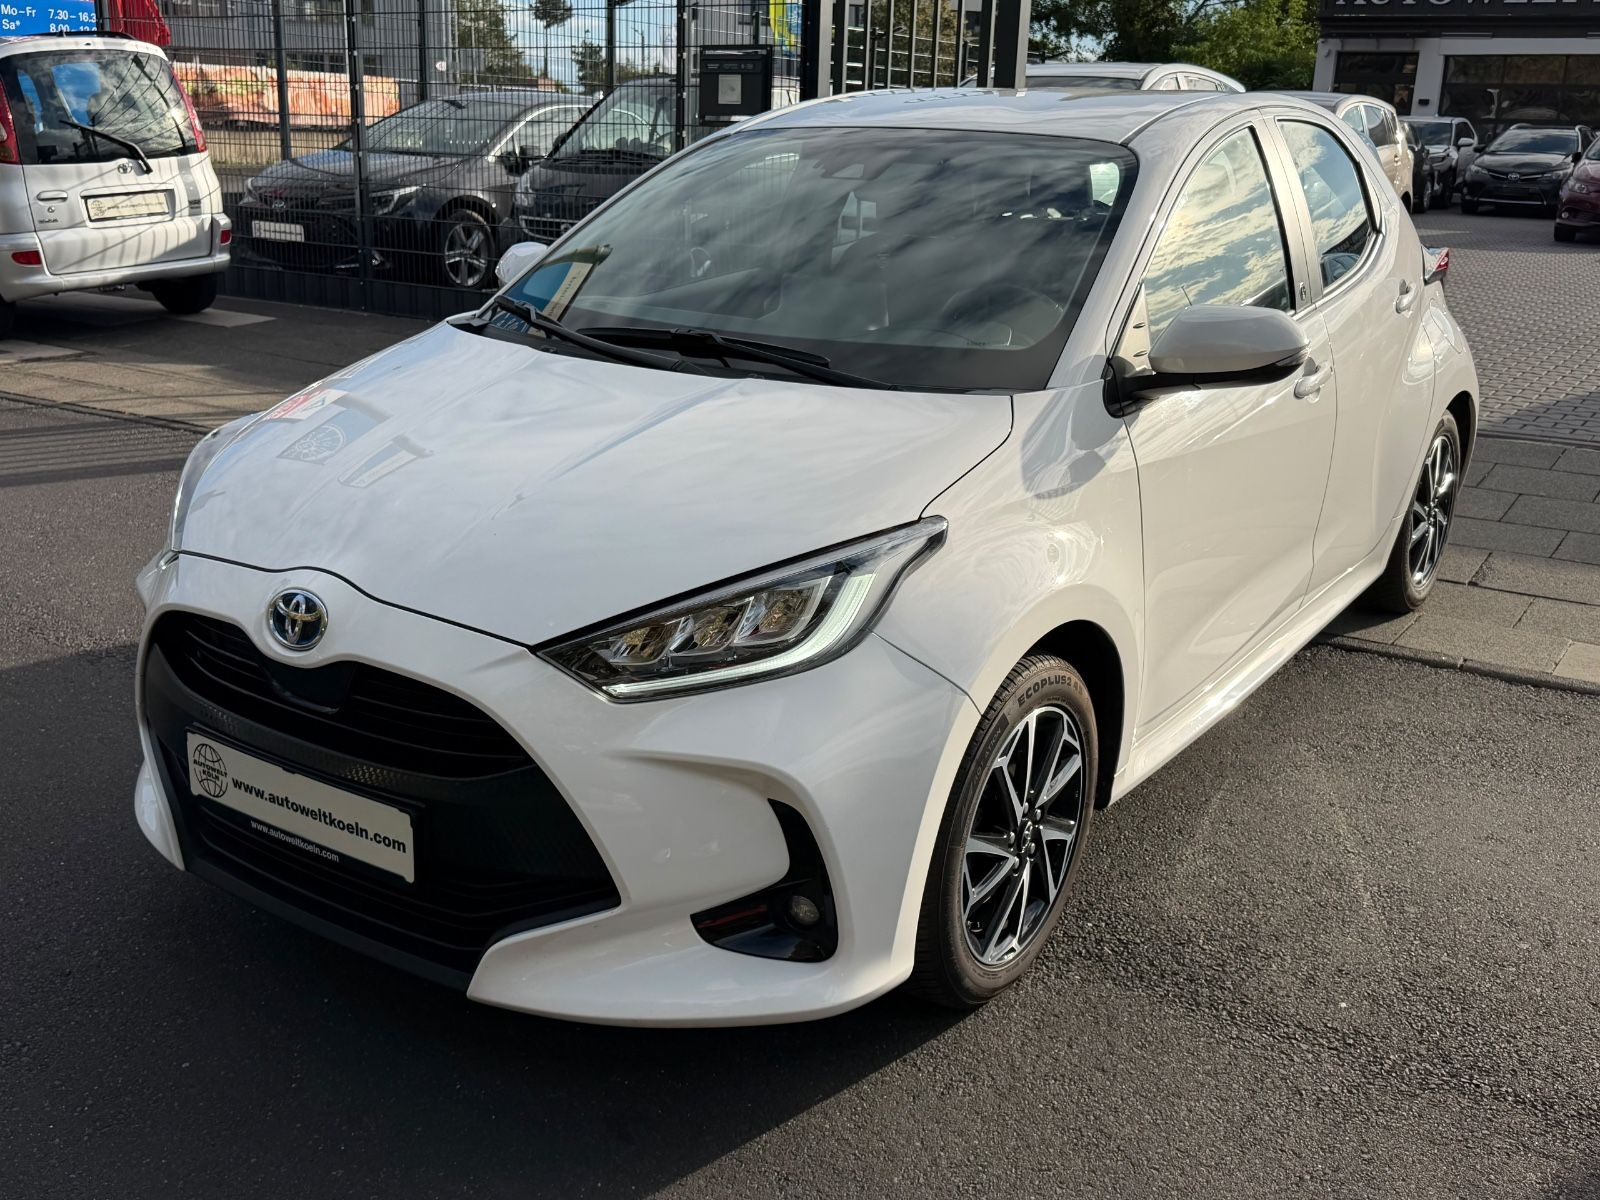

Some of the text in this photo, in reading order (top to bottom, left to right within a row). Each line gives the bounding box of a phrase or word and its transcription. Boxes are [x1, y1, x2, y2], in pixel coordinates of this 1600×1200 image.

[193, 759, 228, 778] AUTOWELT
[232, 777, 406, 853] www.autoweltkoeln.com
[250, 820, 339, 862] www.autoweltkoeln.com
